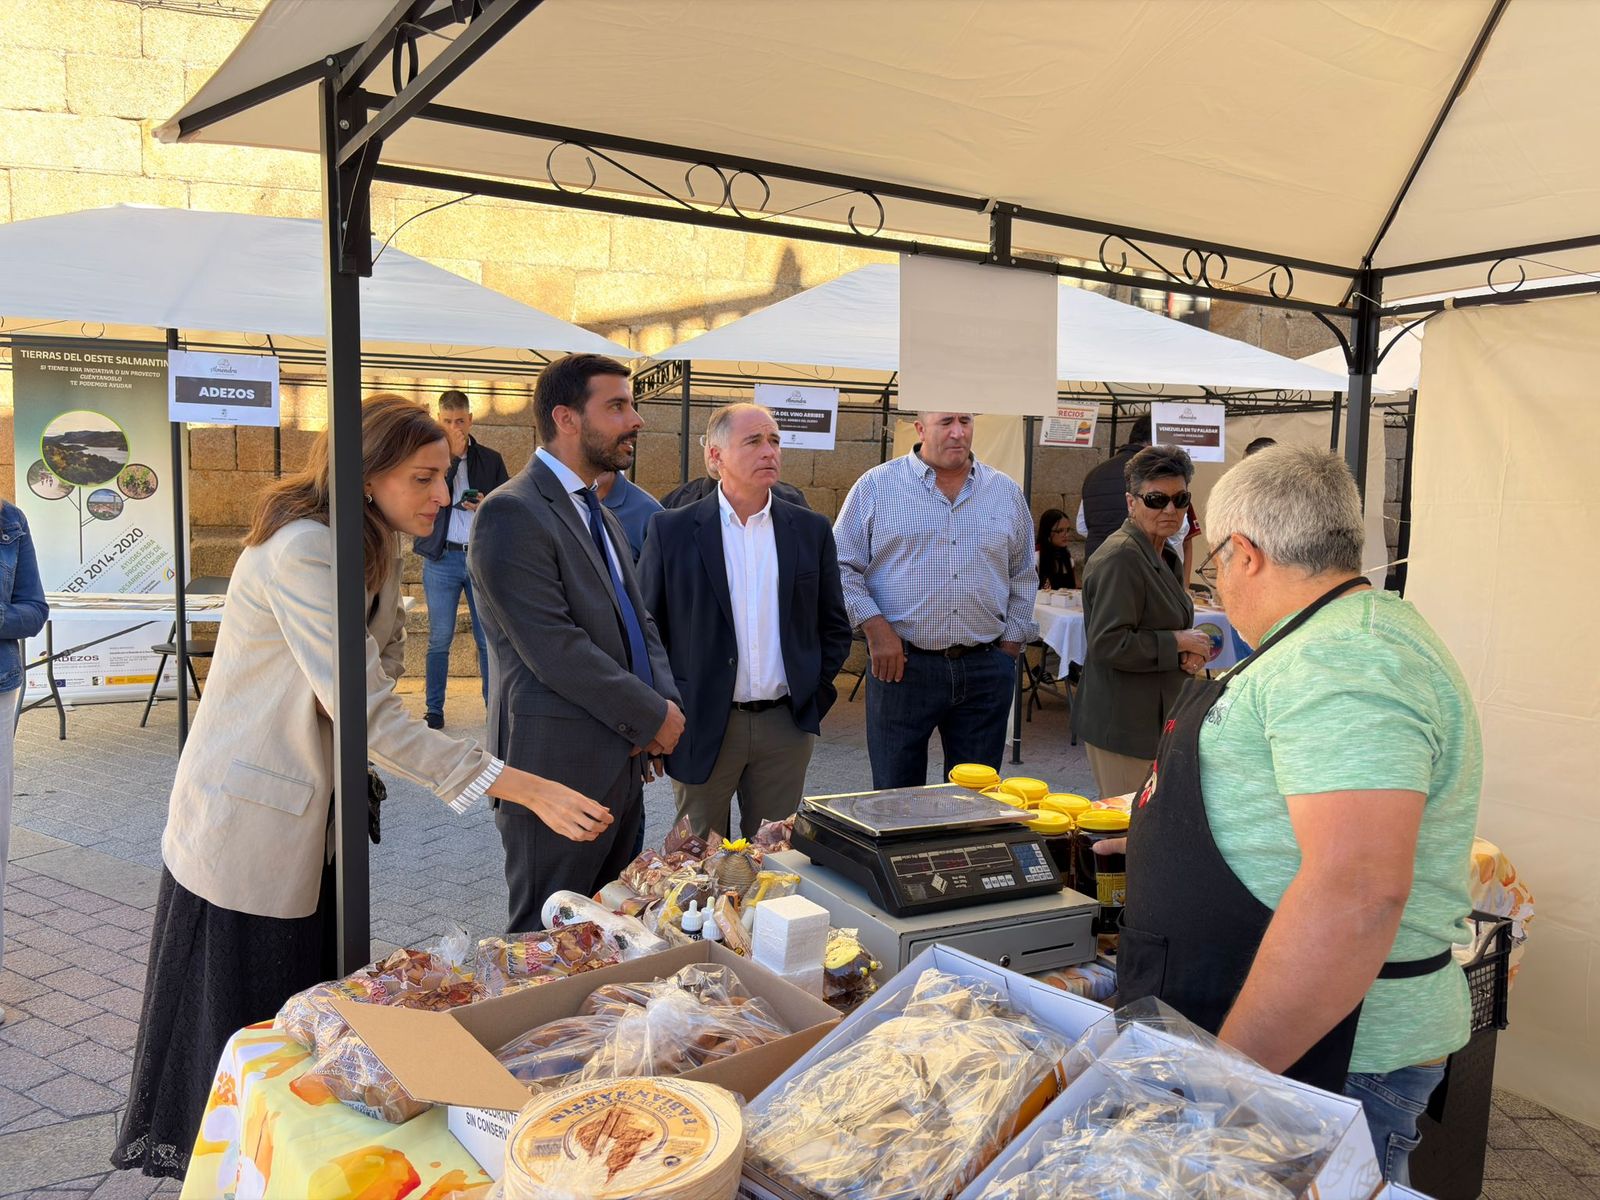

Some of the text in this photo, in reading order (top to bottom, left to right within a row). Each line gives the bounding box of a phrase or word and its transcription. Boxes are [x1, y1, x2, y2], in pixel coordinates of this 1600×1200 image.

[20, 350, 62, 360] TIERRAS
[64, 352, 82, 362] DEL
[84, 354, 114, 364] OESTE
[198, 386, 255, 400] ADEZOS
[84, 528, 144, 580] 2014-2020
[121, 539, 155, 570] AYUDAS PARA
[125, 544, 161, 577] PROYECTOS DE
[119, 565, 151, 593] DESARROLLO
[150, 550, 168, 567] RURAL
[466, 1112, 510, 1140] SIN CONSERV
